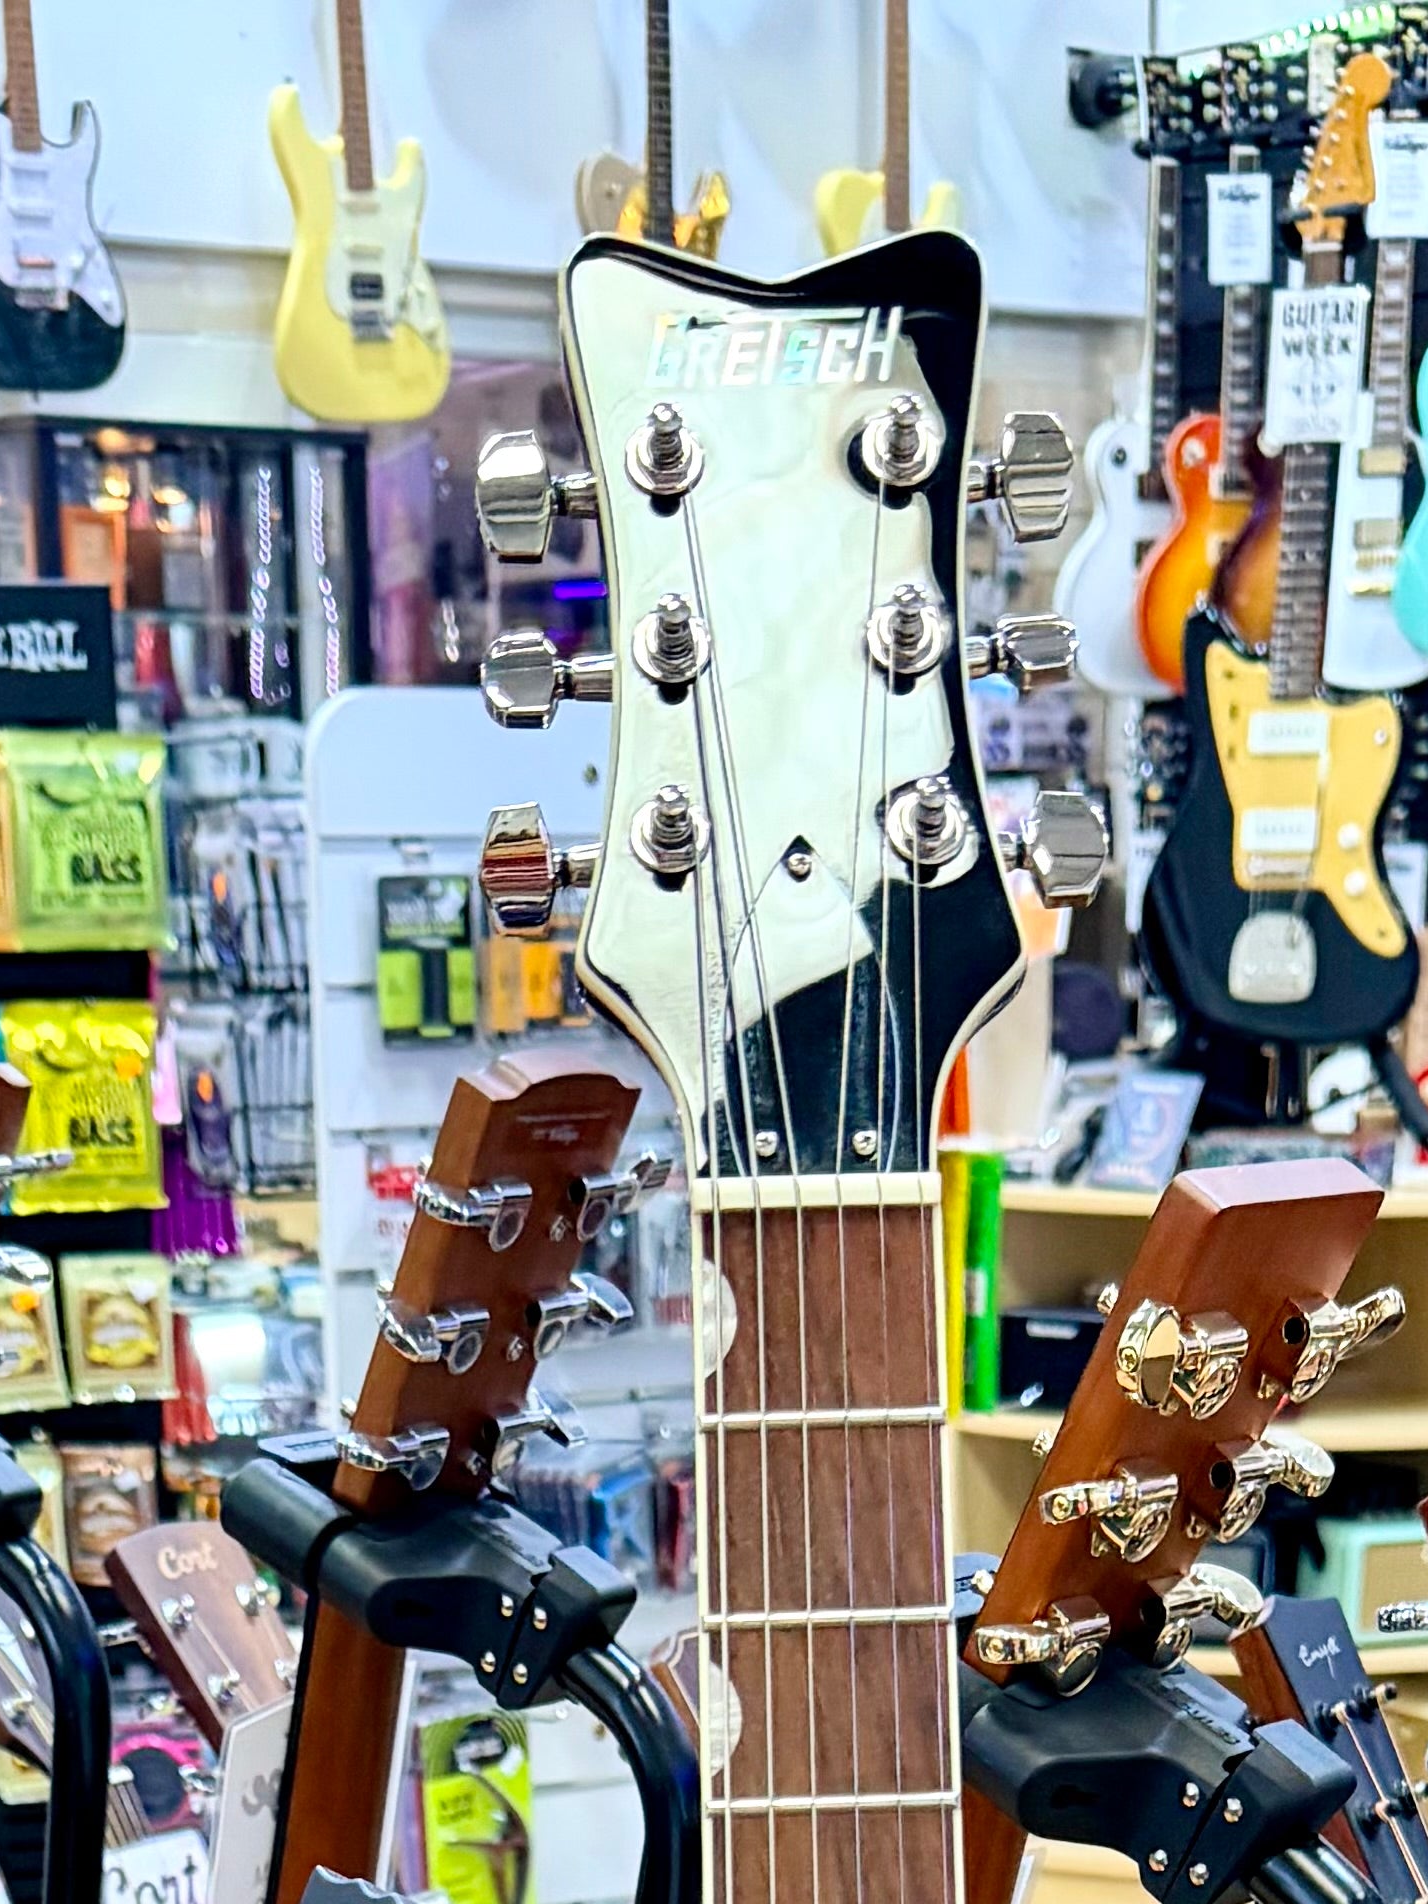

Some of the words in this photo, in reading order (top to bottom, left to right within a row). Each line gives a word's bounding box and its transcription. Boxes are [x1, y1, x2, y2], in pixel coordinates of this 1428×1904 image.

[644, 305, 904, 390] GRETSCH
[69, 852, 145, 887] BASS
[67, 1114, 137, 1149] BASS
[156, 1541, 219, 1580] Cort
